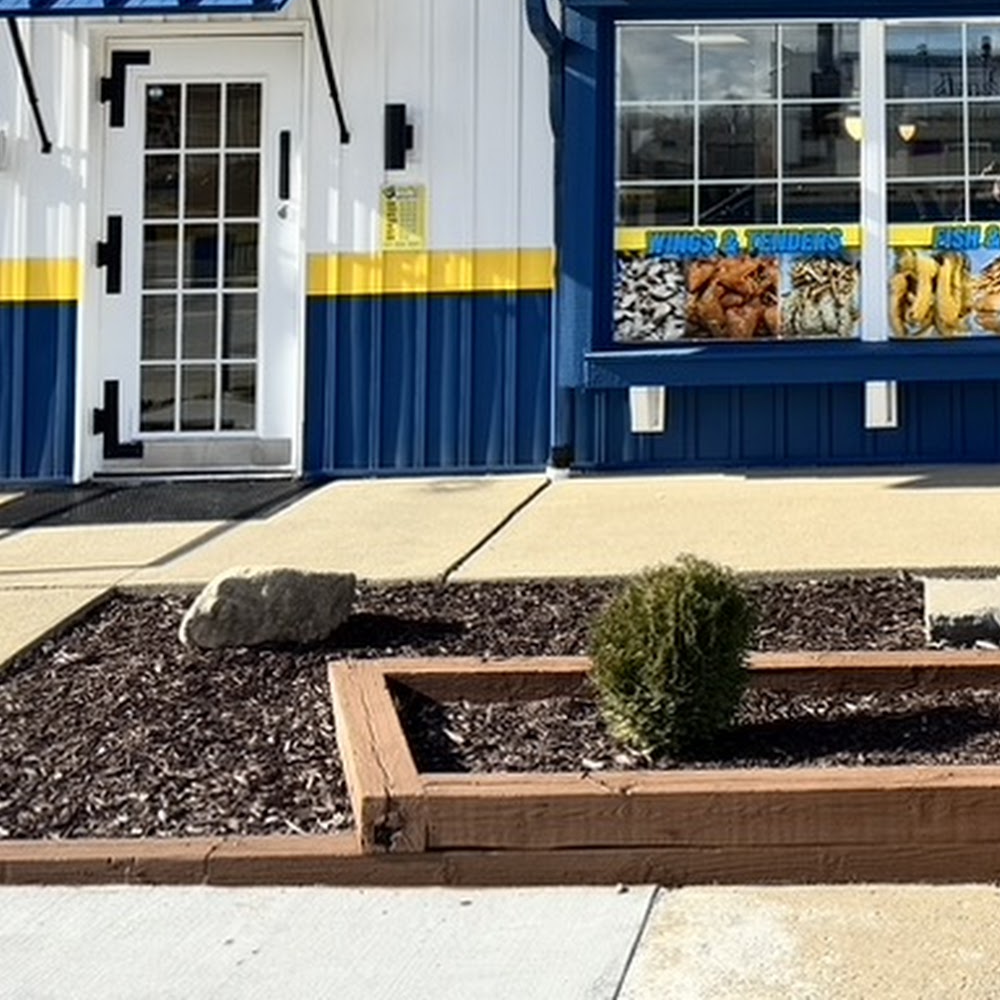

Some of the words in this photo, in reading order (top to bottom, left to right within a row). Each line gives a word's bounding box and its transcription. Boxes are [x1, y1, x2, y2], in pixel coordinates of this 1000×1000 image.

[647, 230, 717, 255] WINGS
[719, 229, 740, 256] &
[745, 228, 843, 254] TENDERS
[933, 226, 981, 249] FISH
